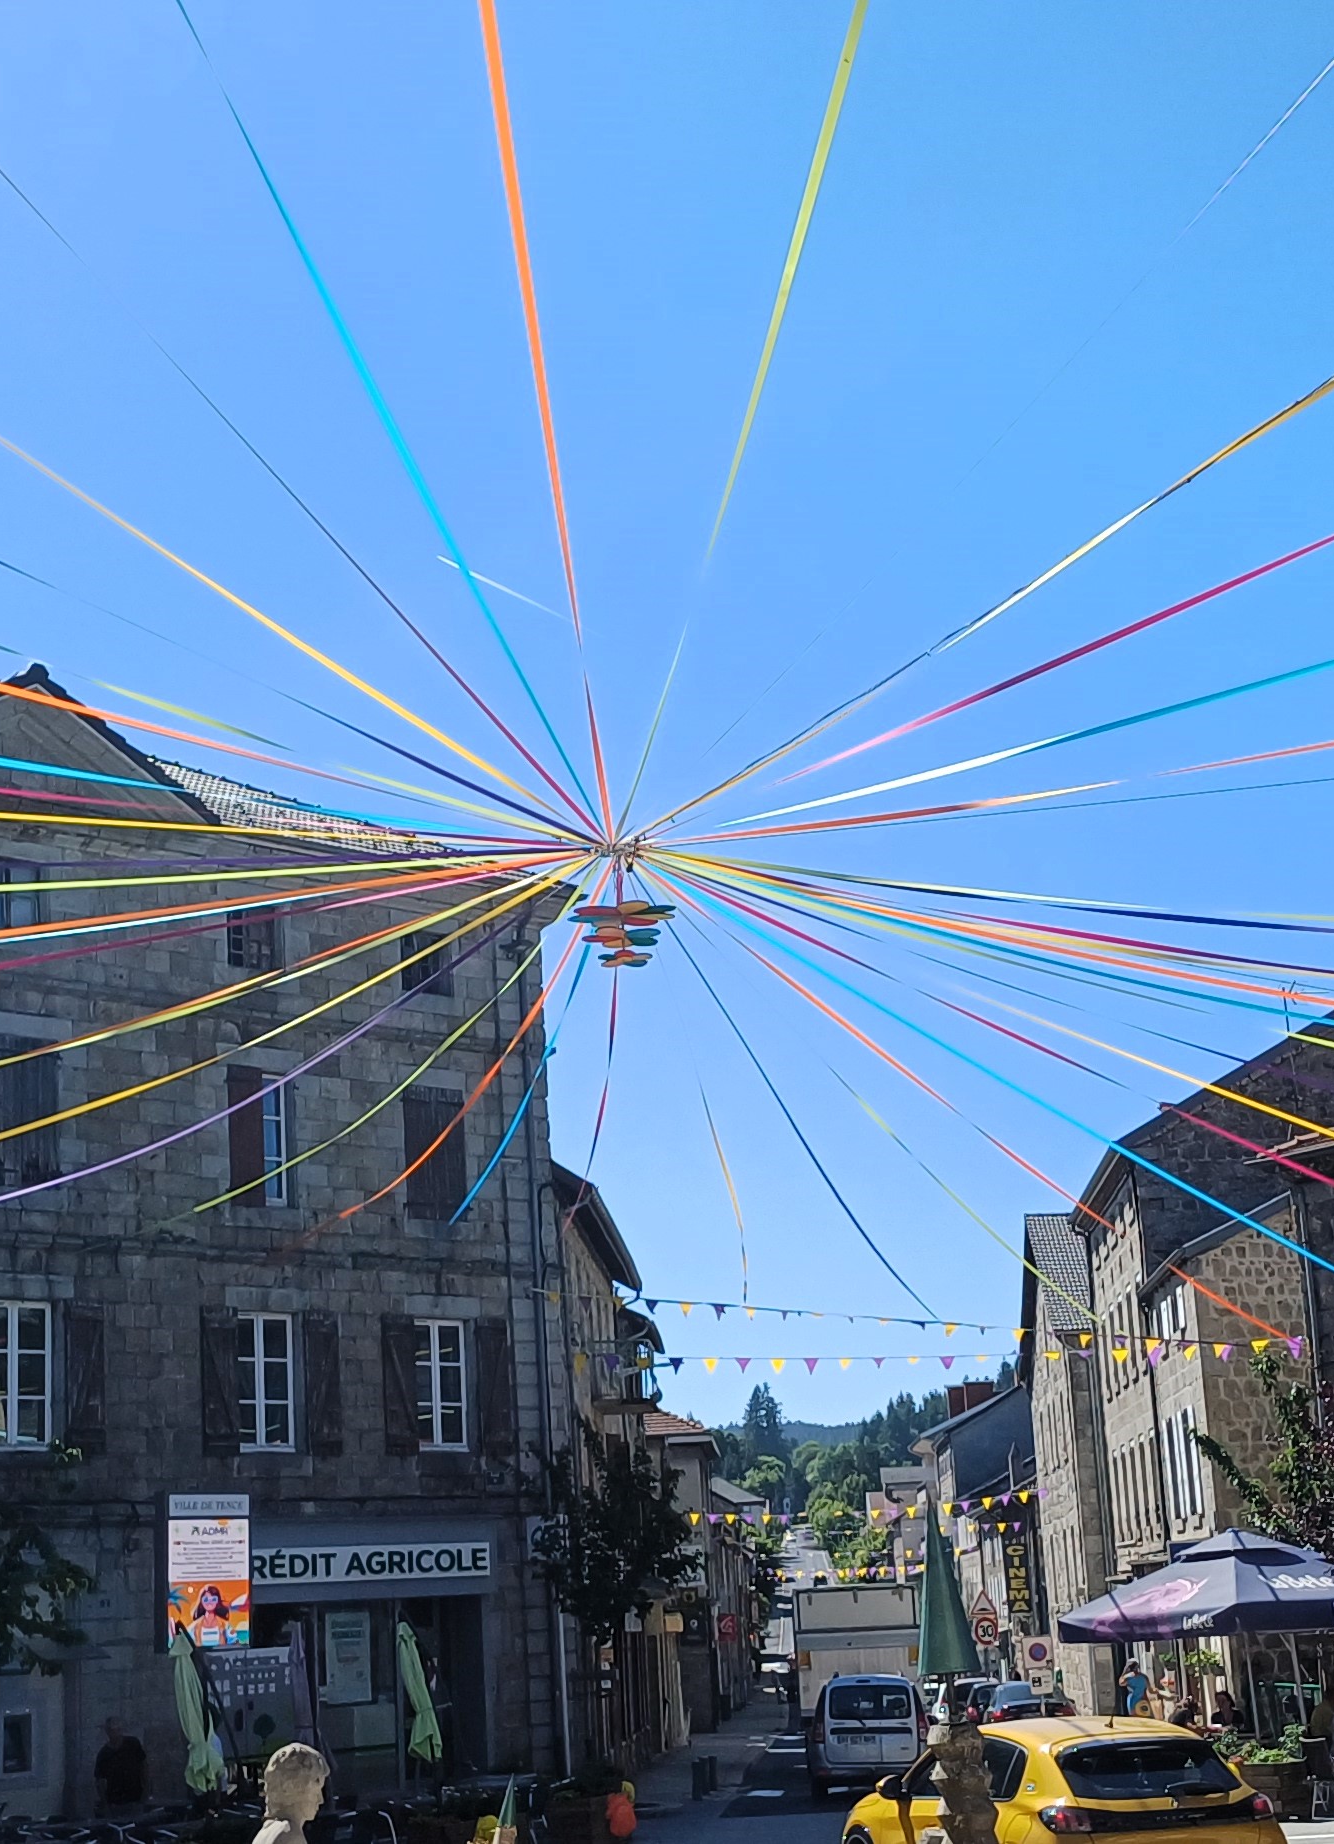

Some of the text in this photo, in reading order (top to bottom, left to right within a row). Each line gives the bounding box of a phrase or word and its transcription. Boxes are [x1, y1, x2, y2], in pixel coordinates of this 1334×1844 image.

[200, 1501, 213, 1510] DE
[251, 1547, 489, 1579] RÉDIT AGRICOLE
[1005, 1545, 1032, 1612] CINEMA
[979, 1624, 994, 1638] 30
